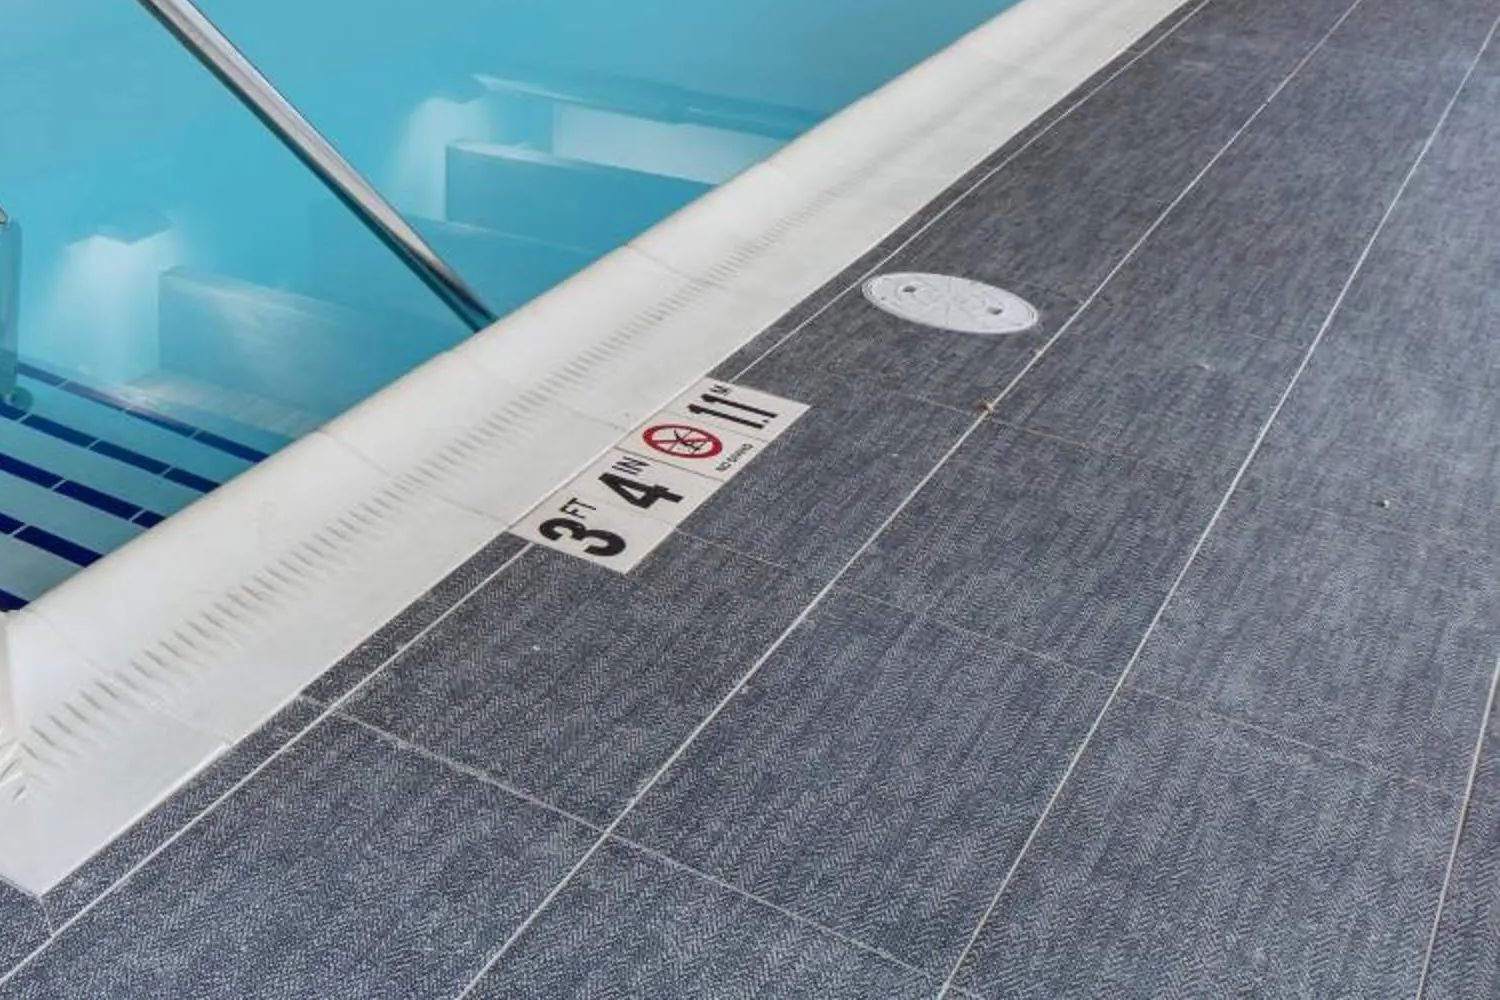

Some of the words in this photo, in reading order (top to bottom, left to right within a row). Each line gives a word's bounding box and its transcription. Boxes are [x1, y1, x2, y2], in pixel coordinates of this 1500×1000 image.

[612, 456, 650, 477] IN
[598, 472, 684, 510] 4
[559, 497, 597, 520] FT
[538, 518, 626, 557] 3
